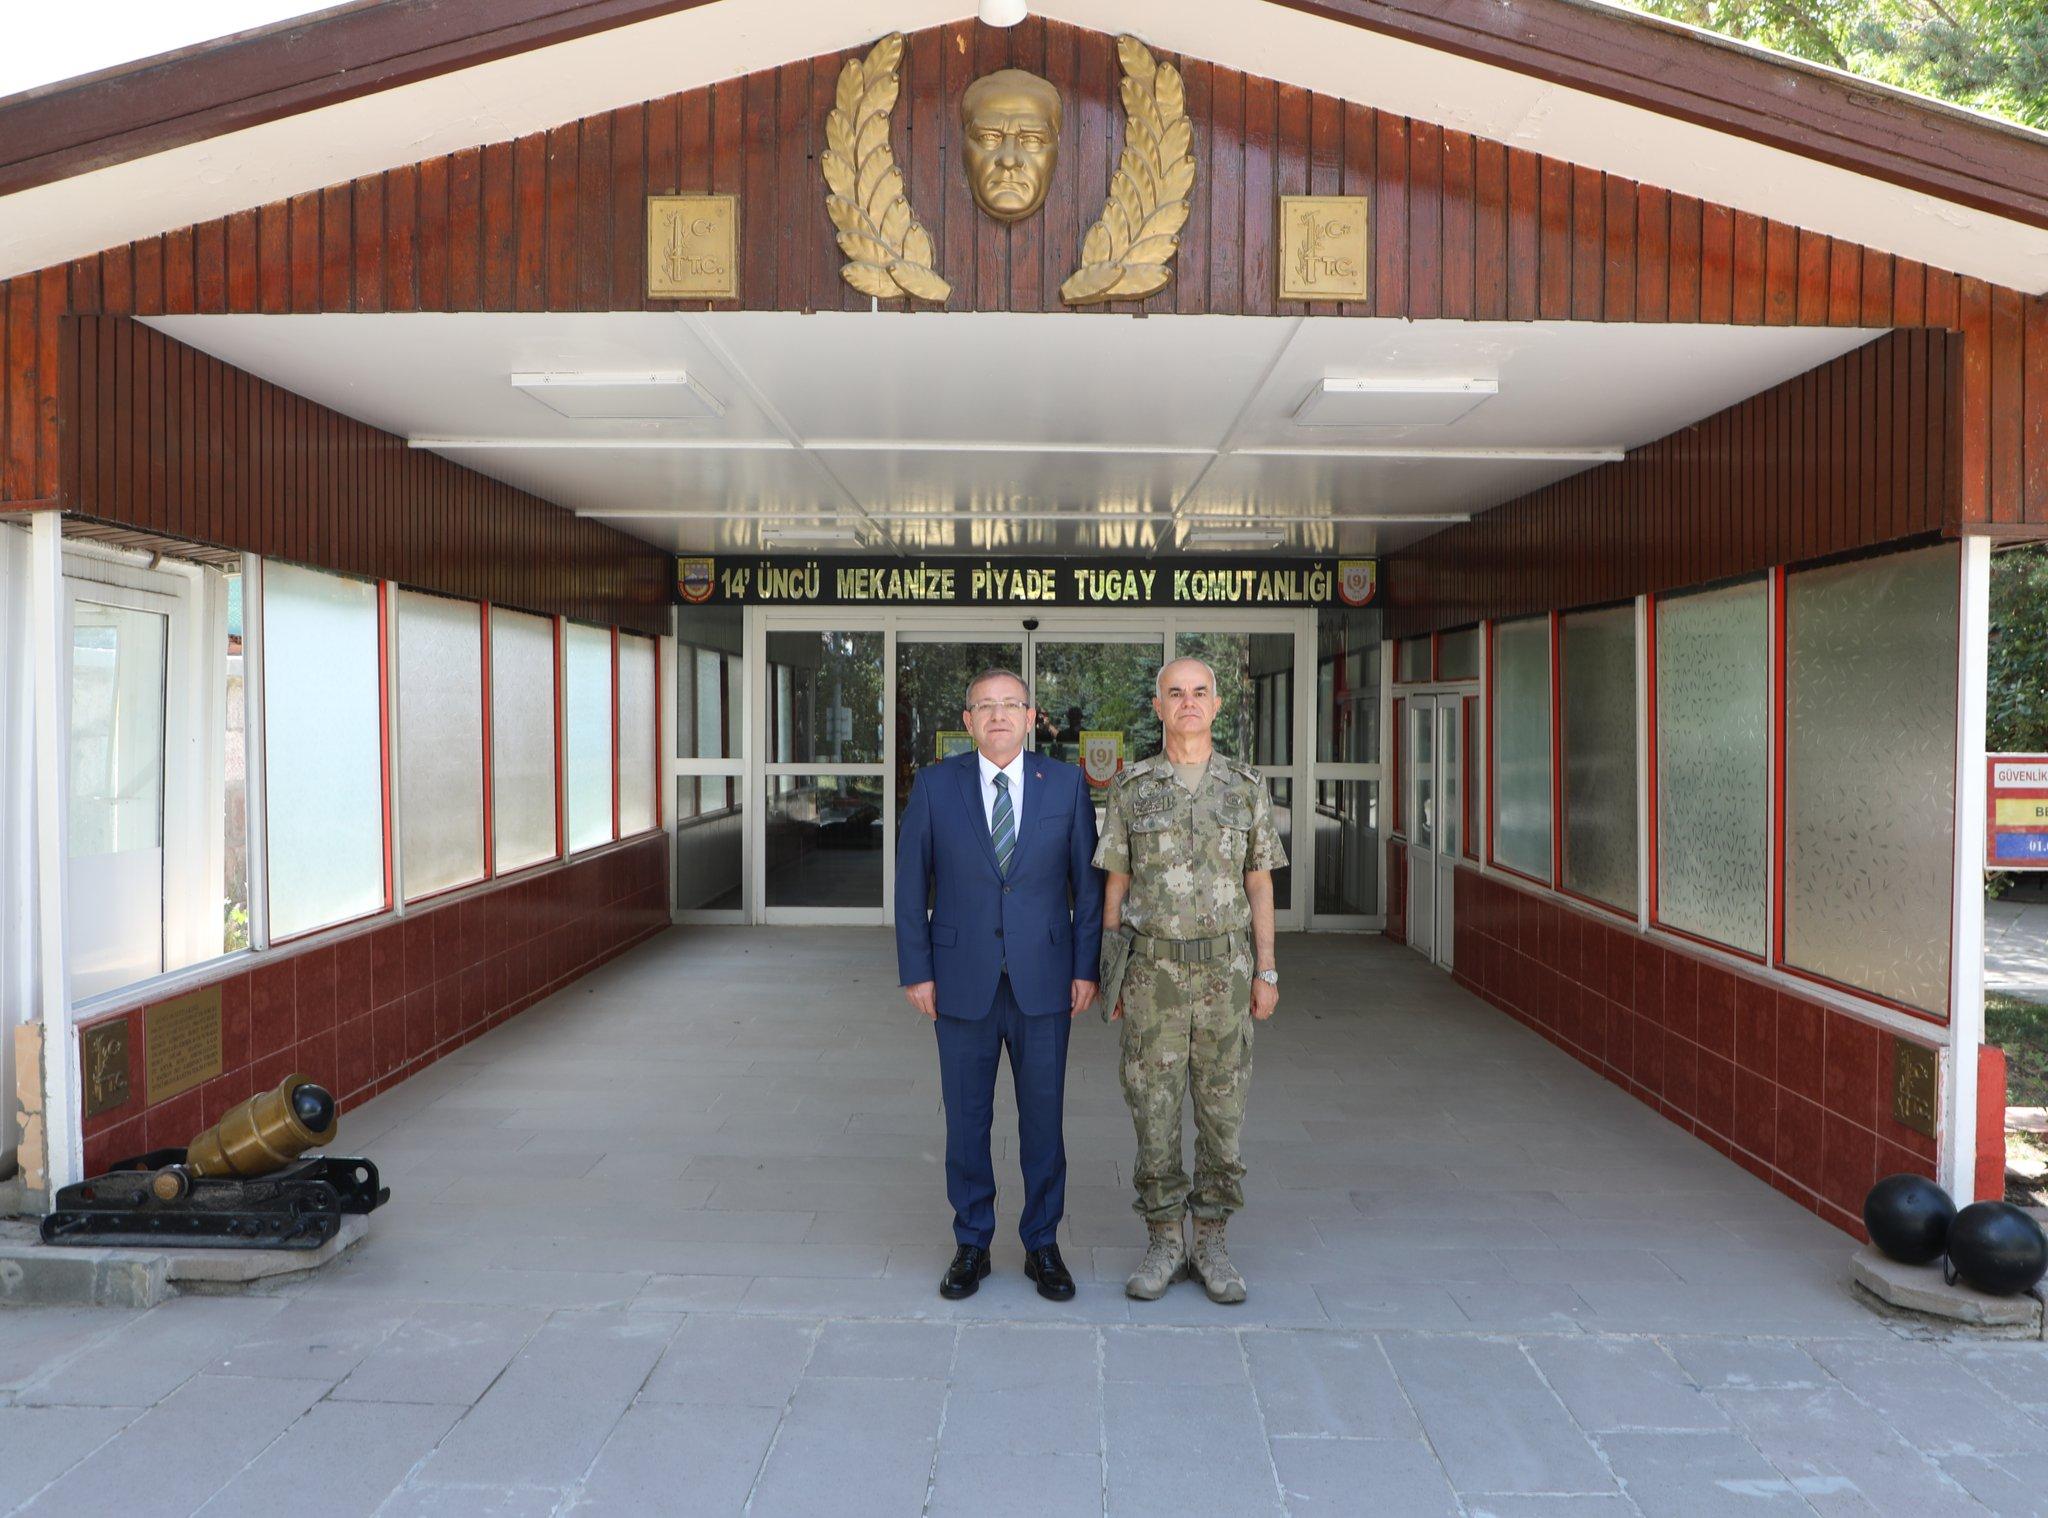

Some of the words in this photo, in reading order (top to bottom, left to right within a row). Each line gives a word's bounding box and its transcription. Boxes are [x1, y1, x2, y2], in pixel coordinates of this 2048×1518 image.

[757, 561, 819, 599] ÜNCÜ
[836, 561, 955, 599] MEKANİZE
[971, 561, 1055, 600] PİYADE
[1073, 569, 1156, 600] TUGAY
[1173, 561, 1331, 600] KOMUTANLIĞI
[1096, 748, 1107, 763] 9
[1998, 767, 2048, 782] GÜVENLİK
